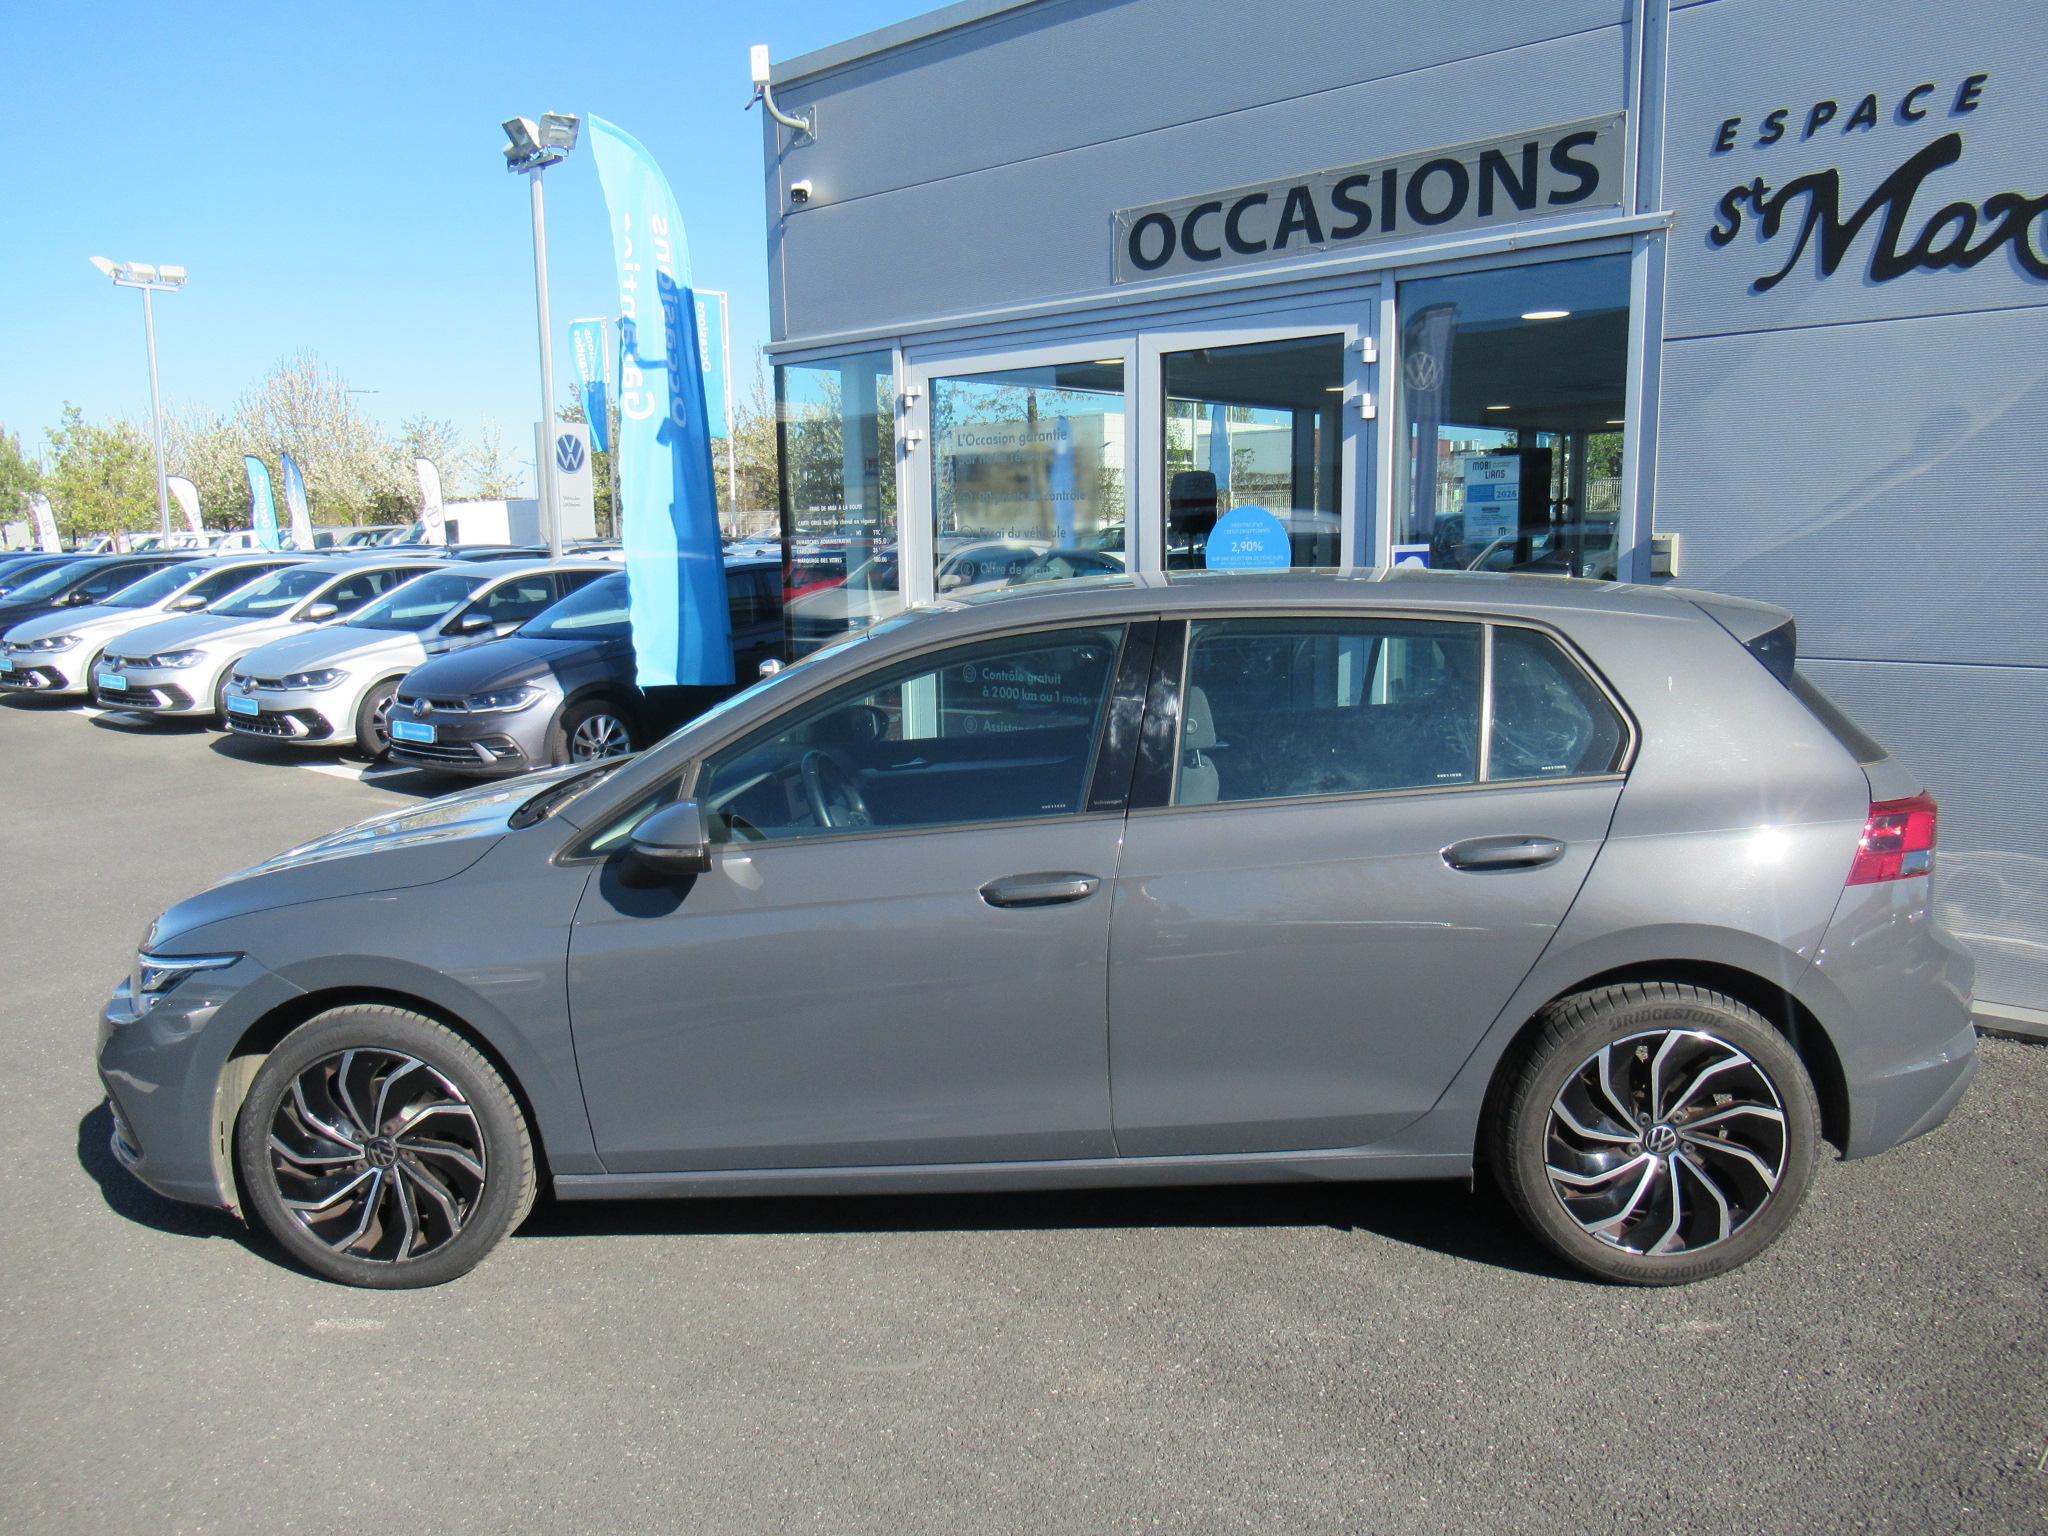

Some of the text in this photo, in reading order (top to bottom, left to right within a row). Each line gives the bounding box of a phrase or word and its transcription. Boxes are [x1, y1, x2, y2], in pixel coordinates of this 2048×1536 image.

[1714, 73, 1989, 152] ESPACE
[1127, 130, 1603, 271] OCCASIONS
[957, 429, 1068, 447] L'Occasion garantie
[1008, 525, 1020, 538] du
[1231, 541, 1264, 554] 2,90%
[980, 562, 1006, 575] Offre
[1009, 562, 1022, 575] de
[982, 667, 1062, 686] Contrôle gratuit
[982, 687, 989, 697] à
[1022, 690, 1037, 701] km
[1039, 692, 1053, 702] ou
[1062, 693, 1088, 705] mois
[1608, 1008, 1724, 1031] BRIDGESTONE
